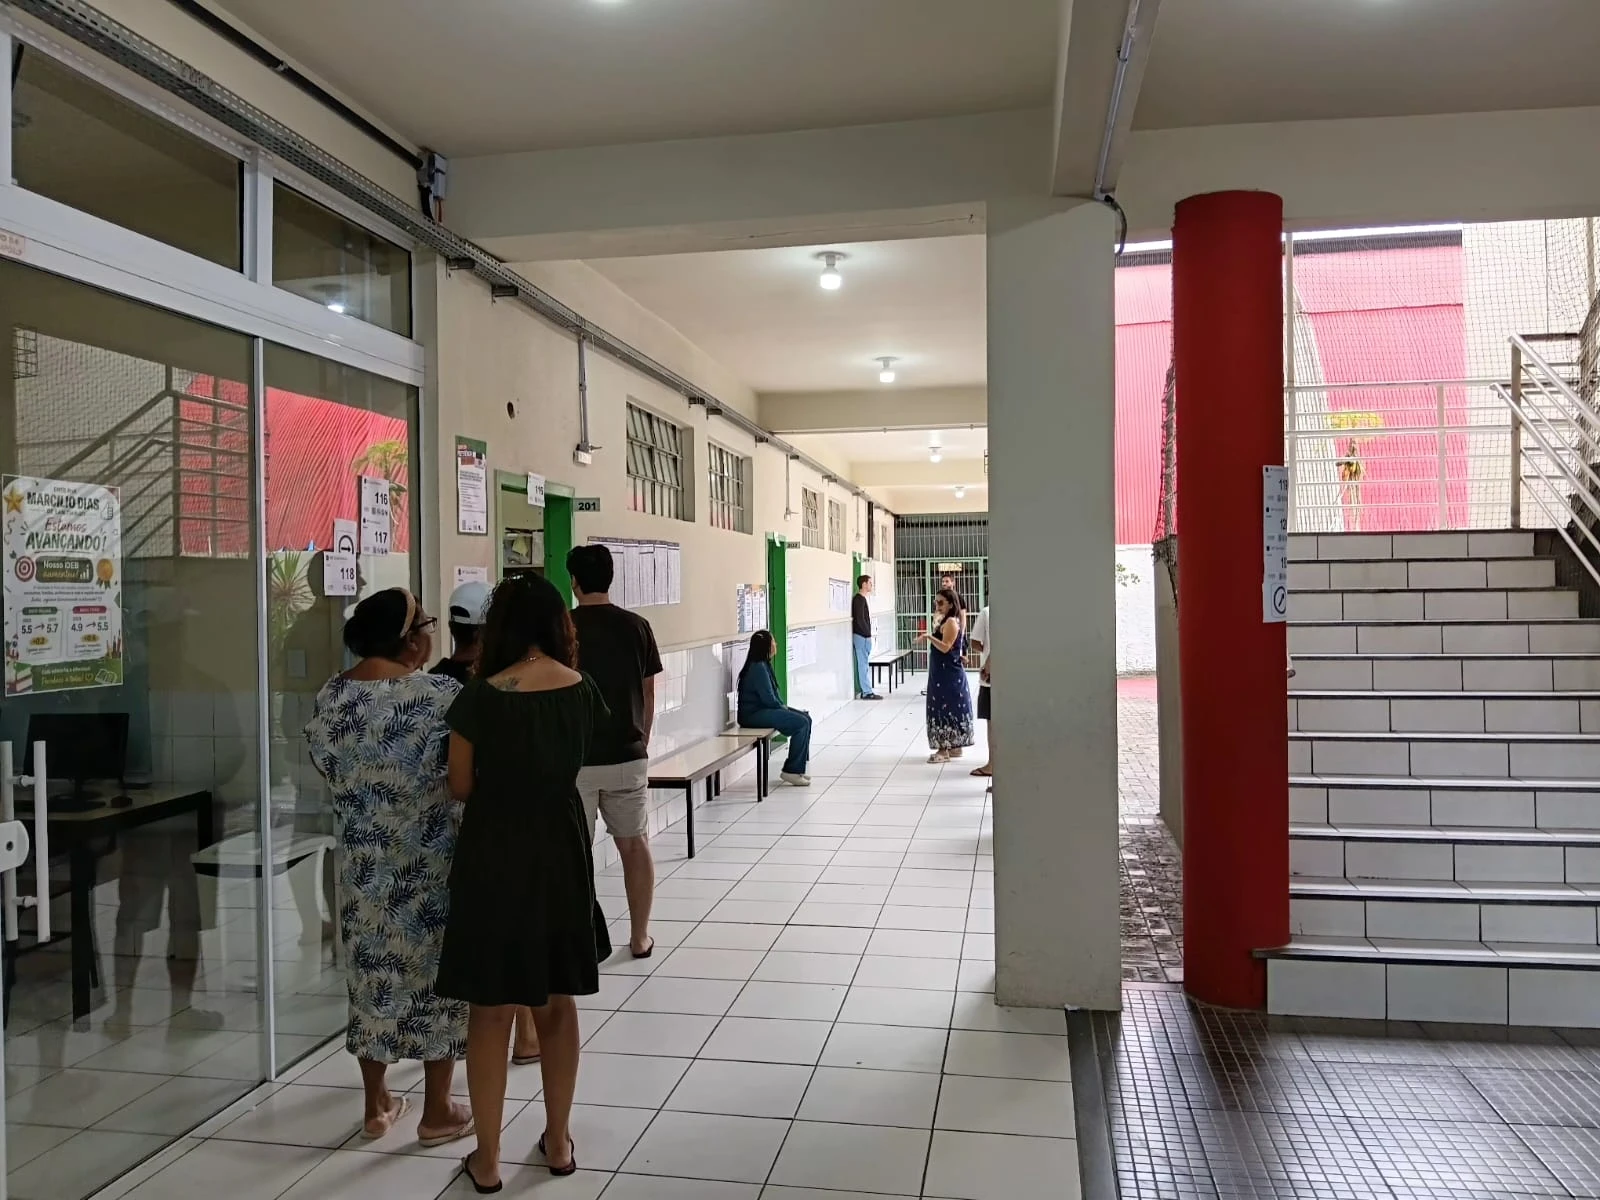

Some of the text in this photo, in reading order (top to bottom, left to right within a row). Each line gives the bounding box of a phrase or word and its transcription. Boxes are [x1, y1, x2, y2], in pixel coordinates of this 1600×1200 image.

[535, 485, 544, 495] 115
[78, 497, 100, 510] DIAS
[375, 492, 388, 505] 116
[578, 502, 597, 511] 201
[45, 517, 87, 532] Estamos
[26, 532, 107, 552] AVANÇANDO!
[375, 531, 388, 544] 117
[43, 560, 64, 569] Nosso
[340, 568, 355, 580] 118
[22, 624, 59, 634] 5.5 5.7
[71, 622, 109, 632] 4.9 5.5
